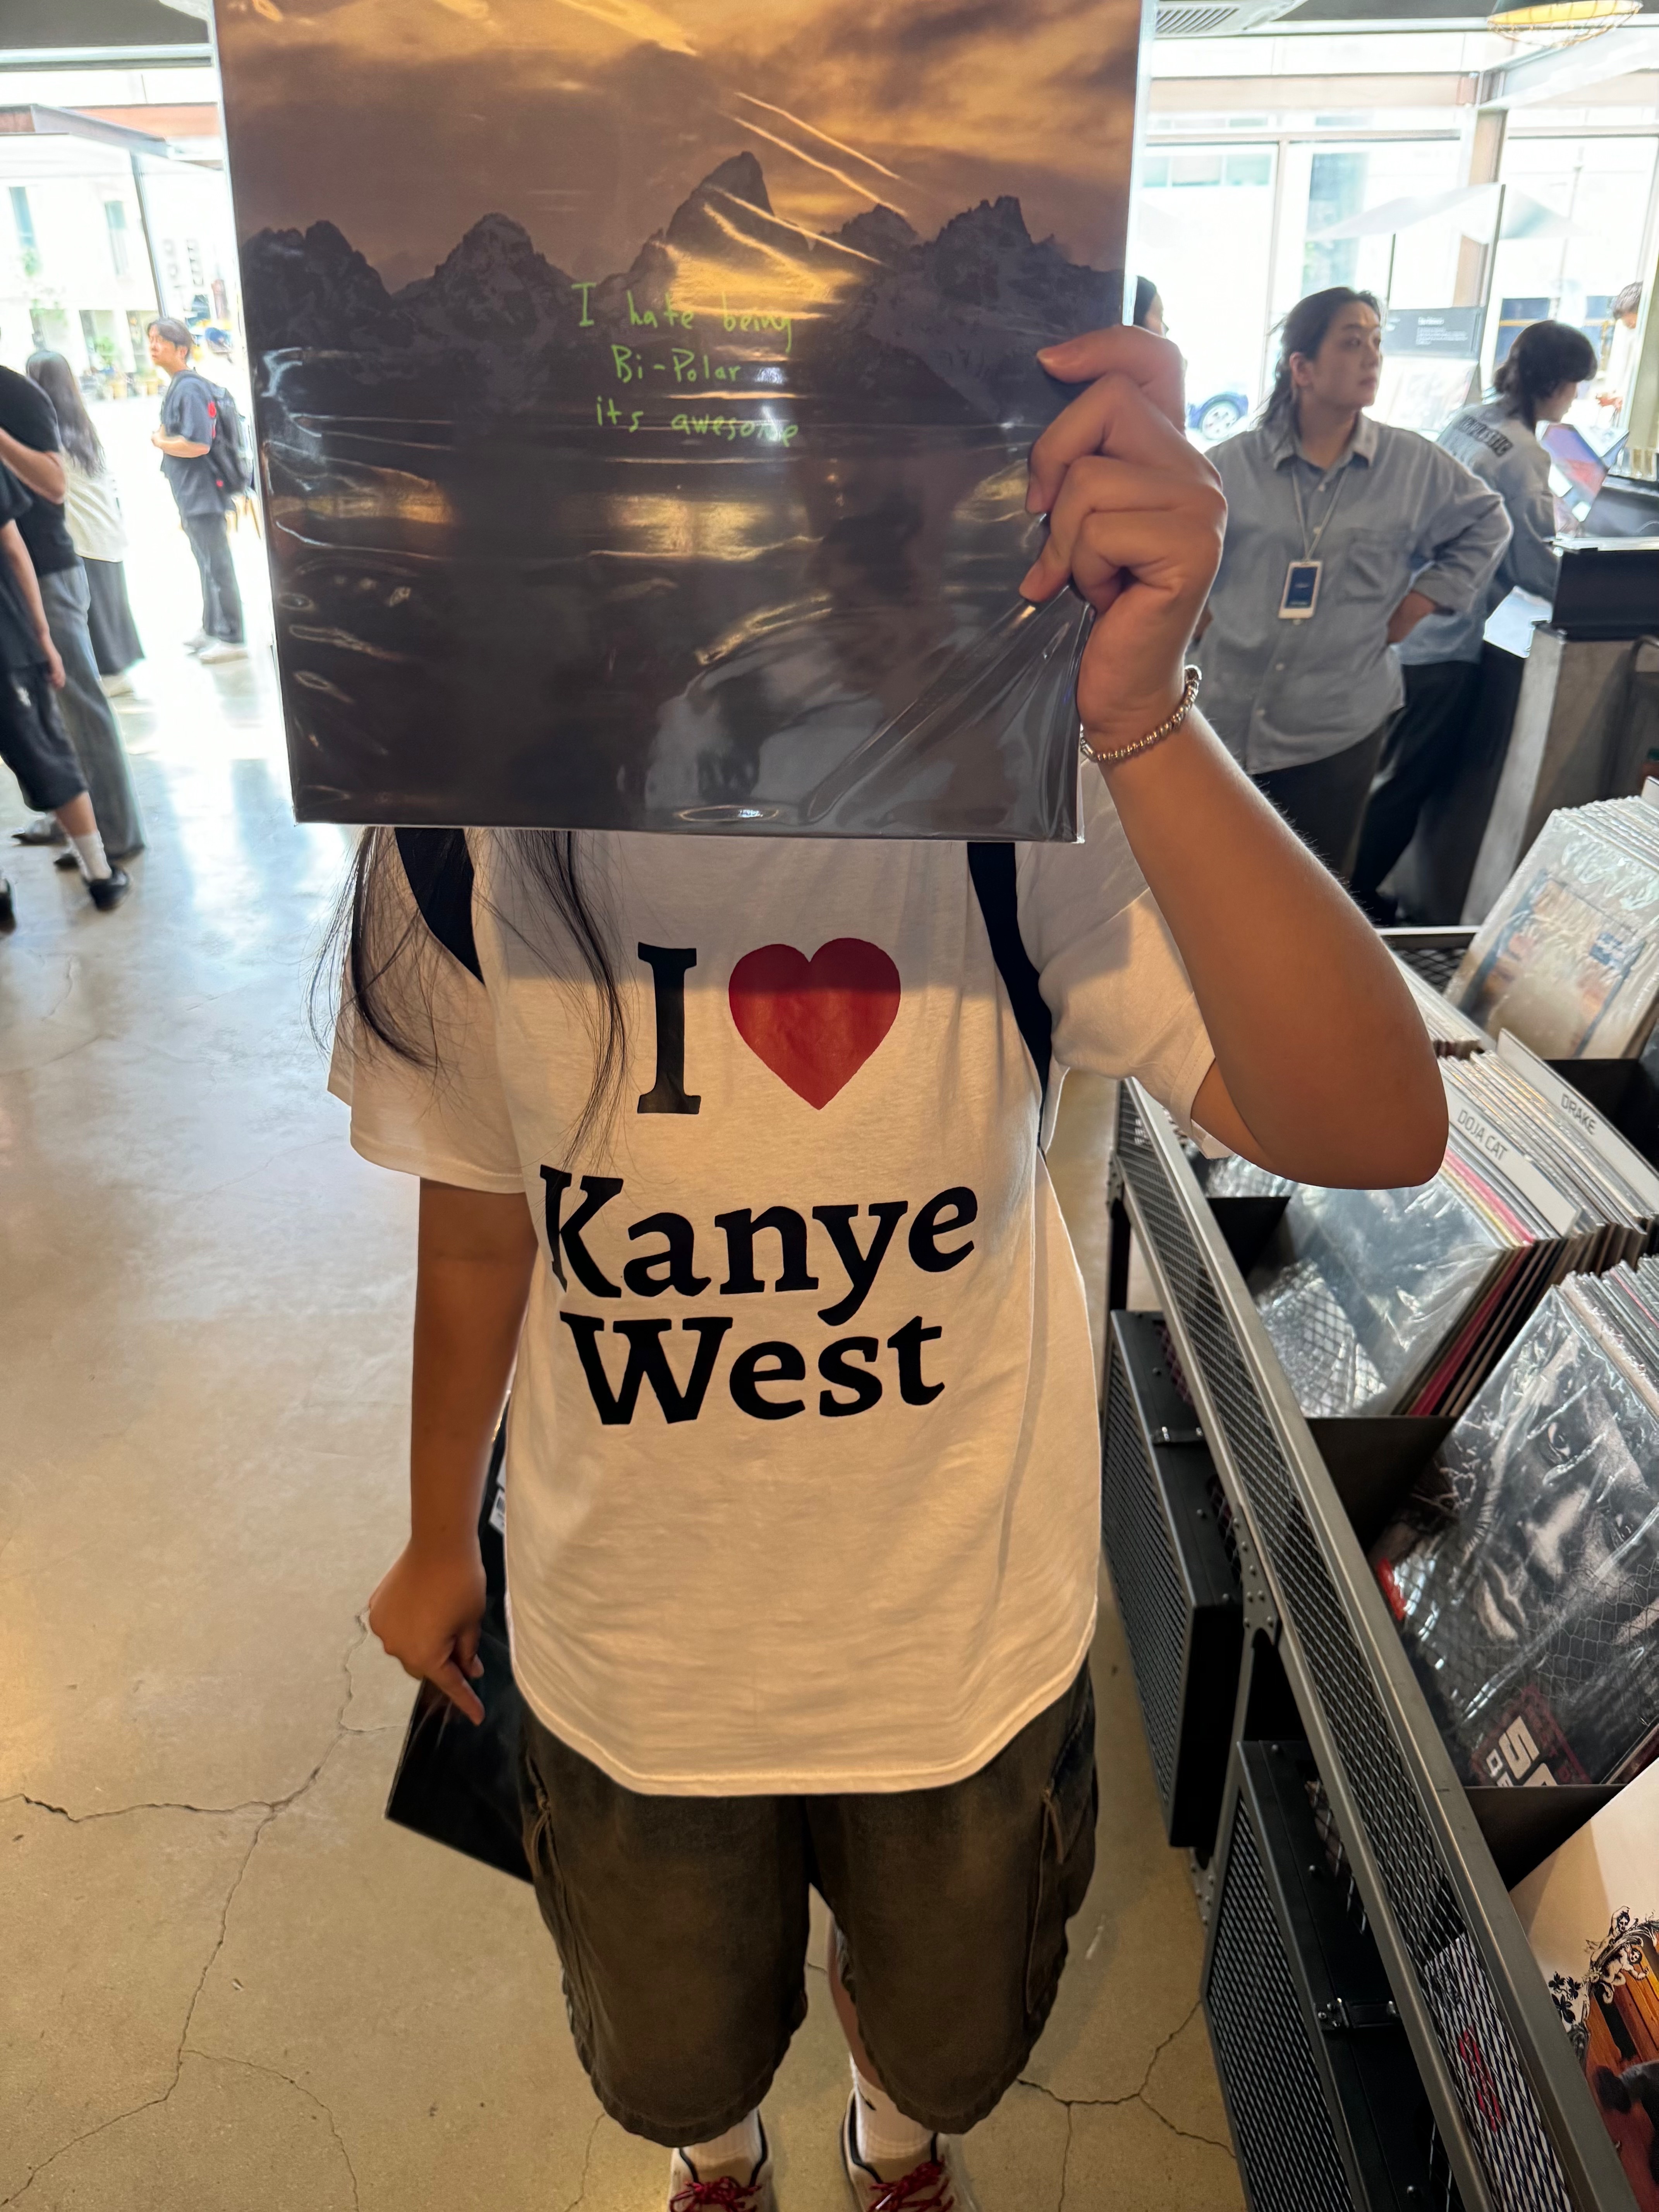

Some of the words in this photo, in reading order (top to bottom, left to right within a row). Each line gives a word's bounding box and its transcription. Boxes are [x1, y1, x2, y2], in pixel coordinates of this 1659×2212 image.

[571, 282, 596, 327] I
[627, 289, 694, 330] hate
[722, 290, 792, 354] being
[611, 344, 741, 383] Bi-Polar
[596, 395, 644, 433] its
[637, 942, 701, 1115] I
[1457, 1109, 1485, 1142] DOJA
[1484, 1135, 1508, 1161] CAT
[1561, 1093, 1597, 1135] DRAKE
[540, 1164, 978, 1326] Kanye
[560, 1311, 945, 1425] West
